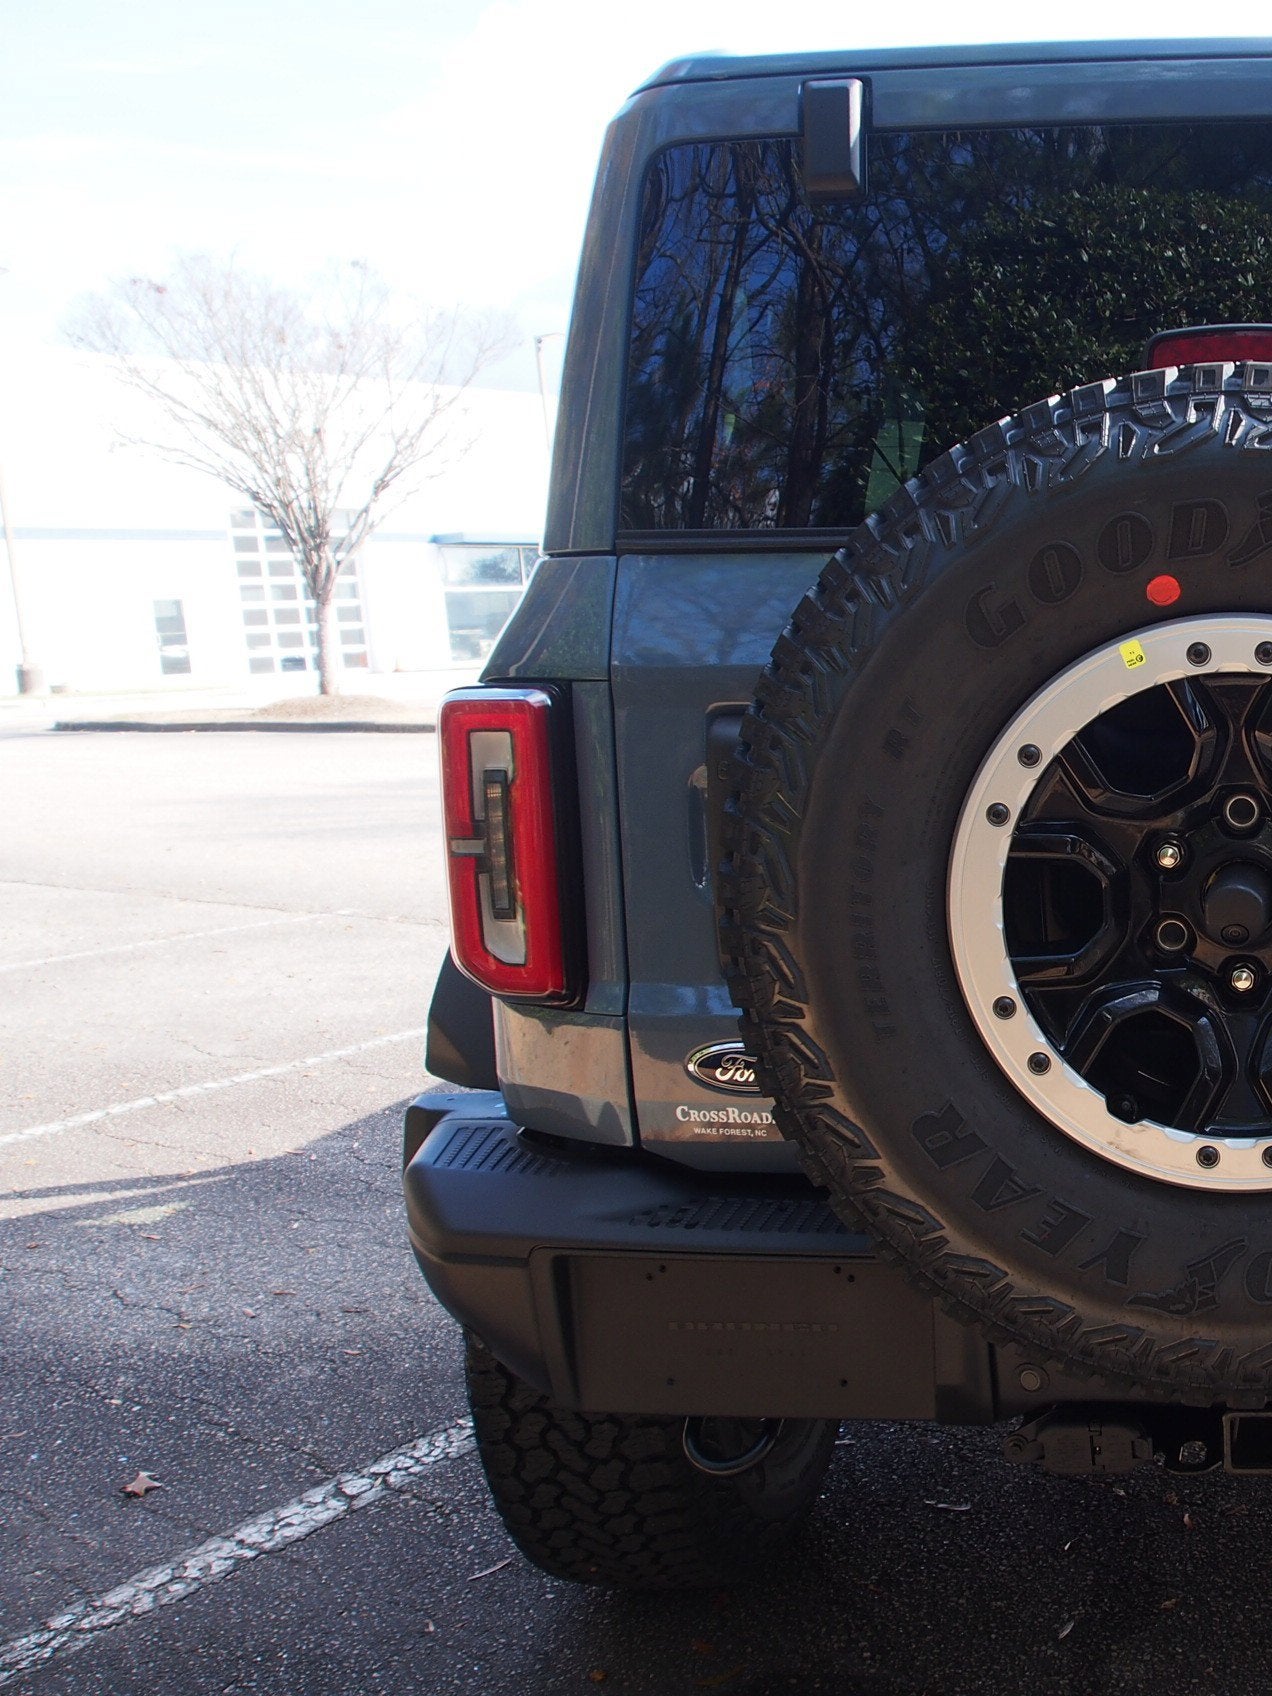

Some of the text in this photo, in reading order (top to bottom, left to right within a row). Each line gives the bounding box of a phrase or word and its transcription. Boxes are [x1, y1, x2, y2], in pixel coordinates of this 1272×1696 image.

[847, 794, 896, 1041] TERRITORY
[693, 1126, 768, 1137] WAKE FOREST, NC
